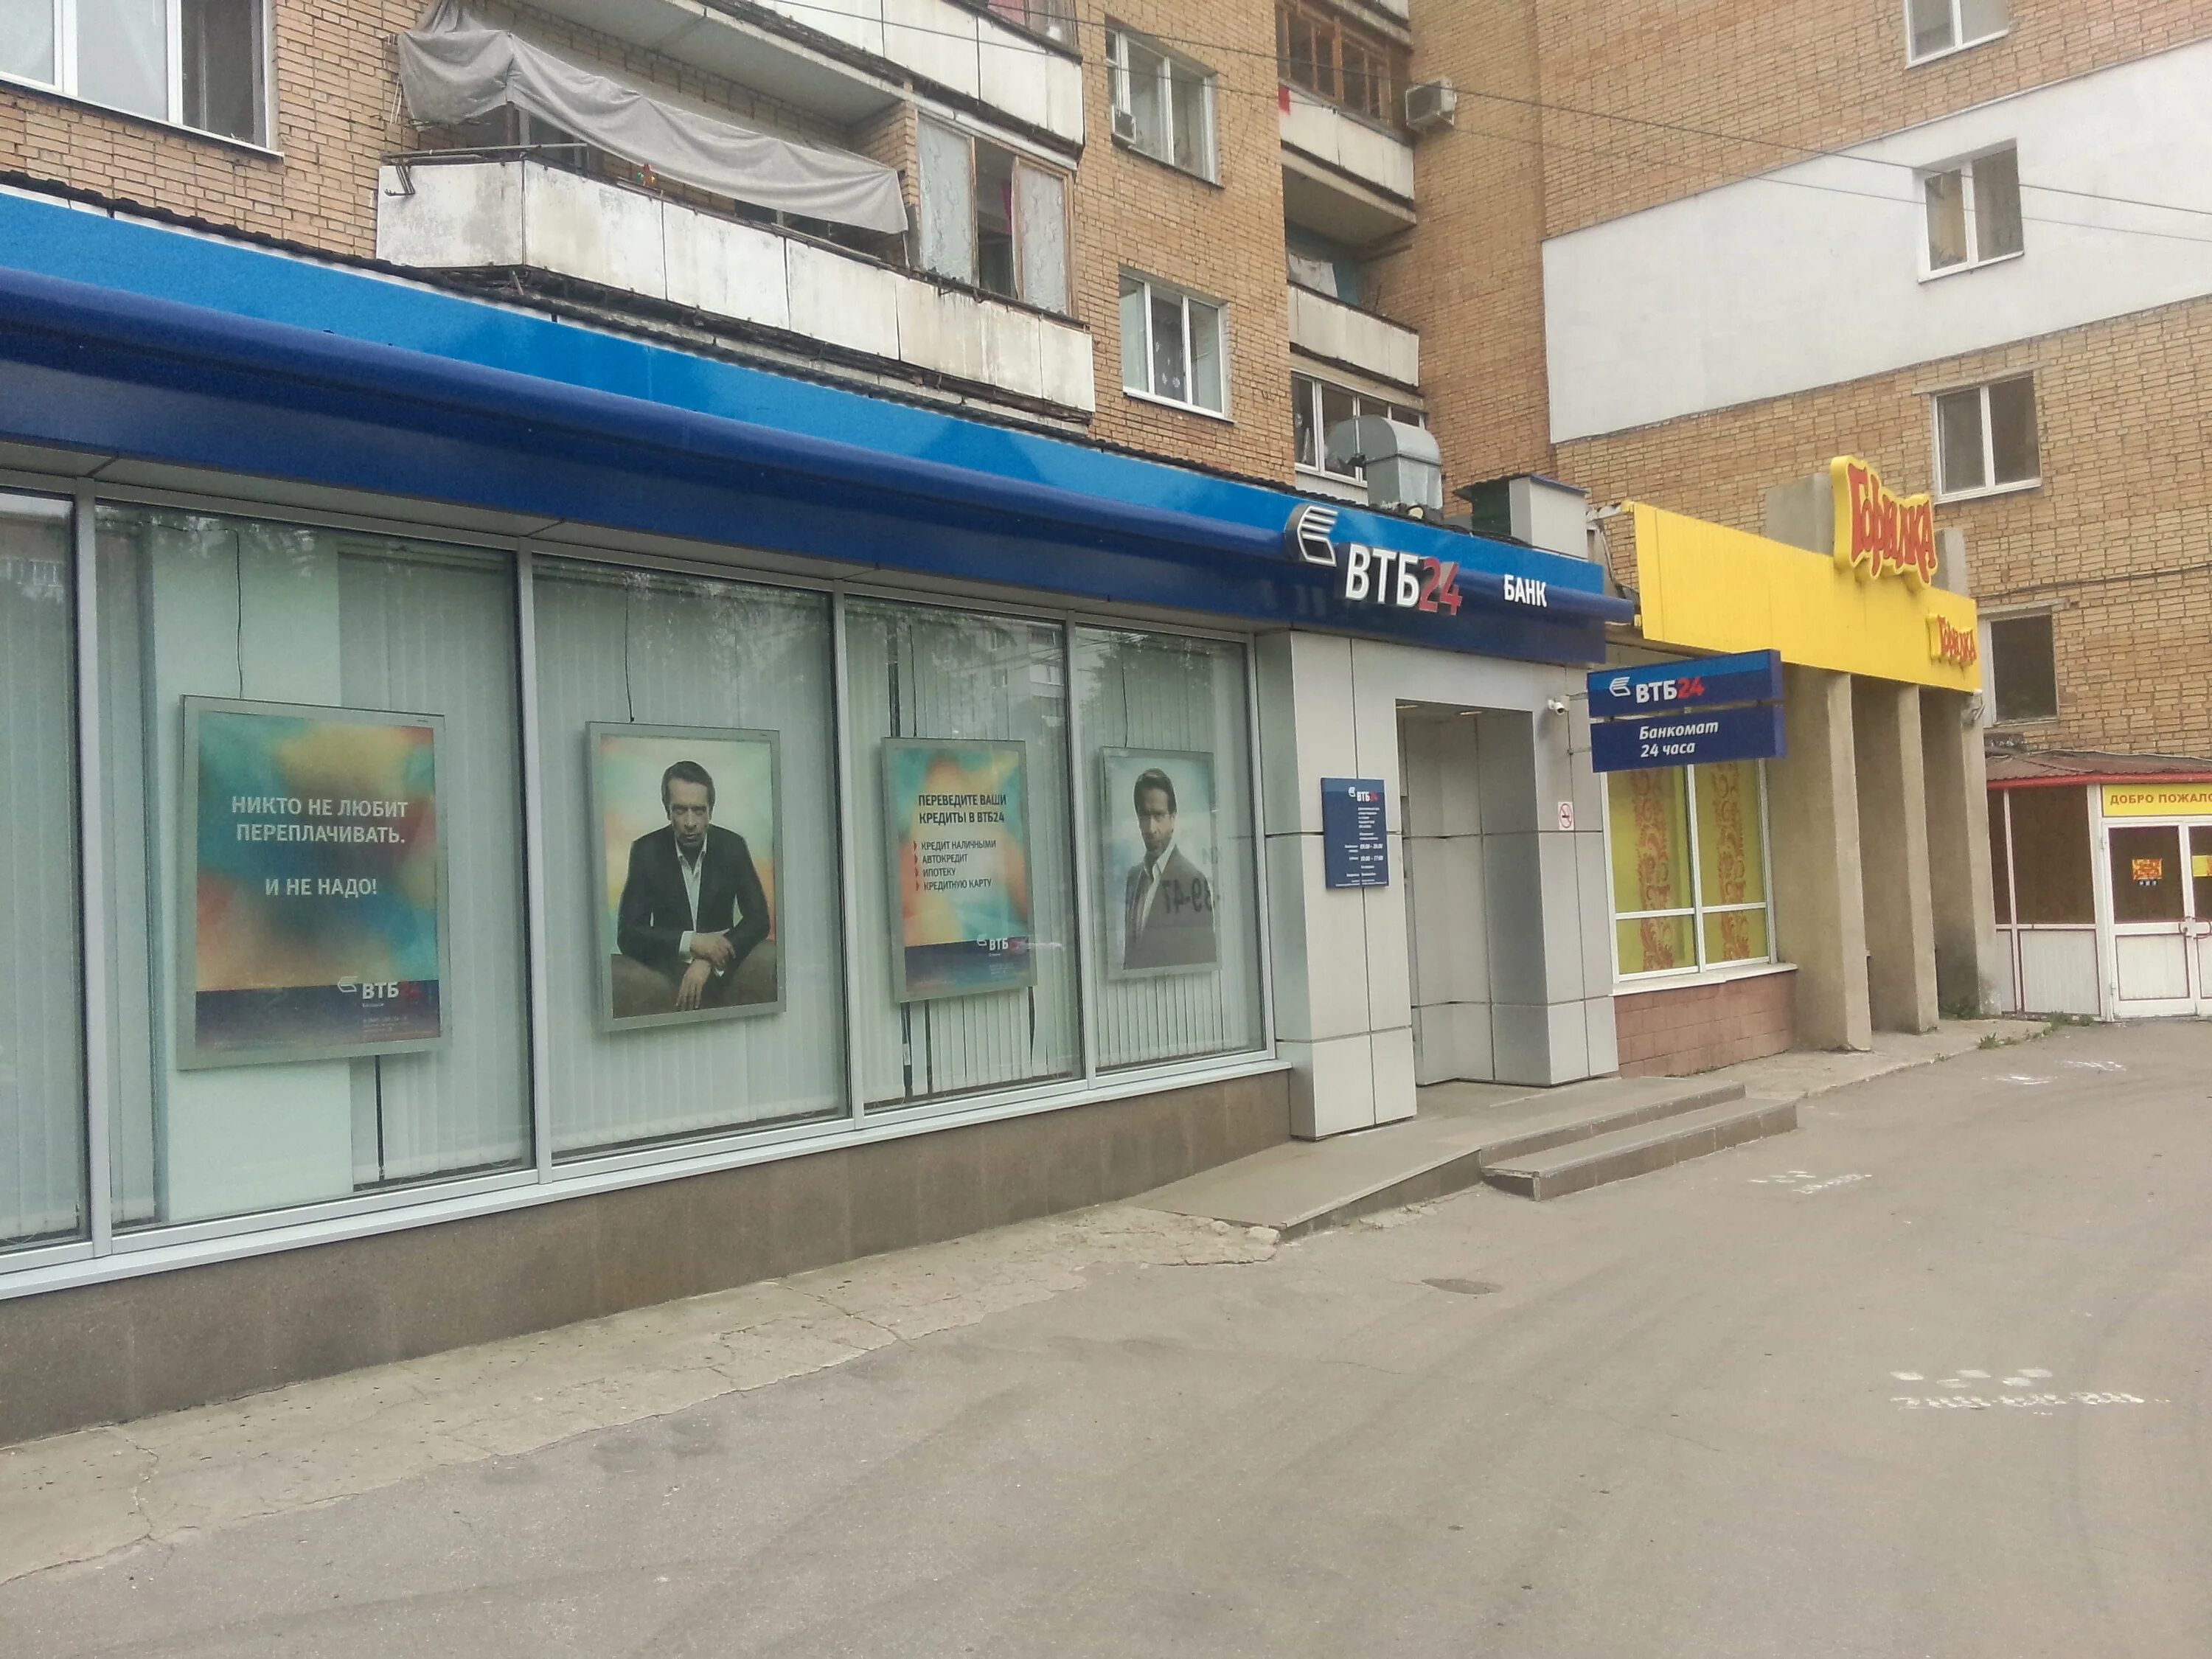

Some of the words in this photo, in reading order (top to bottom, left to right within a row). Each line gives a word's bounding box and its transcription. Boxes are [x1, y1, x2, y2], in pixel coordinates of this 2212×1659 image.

[1345, 543, 1462, 616] ВТБ24
[1503, 574, 1547, 608] БАНК
[1635, 676, 1705, 703] ВТБ24
[1639, 721, 1719, 740] Банкомат
[1640, 745, 1658, 758] 24
[1662, 742, 1695, 755] часа
[232, 796, 302, 814] НИКТО
[308, 799, 333, 815] НЕ
[338, 799, 408, 818] ЛЮБИТ
[918, 794, 978, 808] ПЕРЕВЕДИТЕ
[980, 795, 1006, 805] ВАШИ
[2110, 794, 2154, 805] ДОБРО
[919, 812, 966, 825] КРЕДИТЫ
[969, 813, 975, 823] В
[977, 812, 1004, 823] ВТБ24
[237, 824, 406, 844] ПЕРЕПЛАЧИВАТЬ.
[921, 841, 950, 852] КРЕДИТ
[952, 840, 996, 849] НАЛИЧНЫМИ
[922, 854, 967, 863] АВТОКРЕДИТ
[923, 868, 956, 877] ИПОТЕКУ
[265, 878, 279, 895] И
[286, 878, 311, 895] НЕ
[318, 878, 377, 898] НАДО!
[924, 880, 967, 891] КРЕДИТНУЮ
[969, 879, 991, 888] КАРТУ
